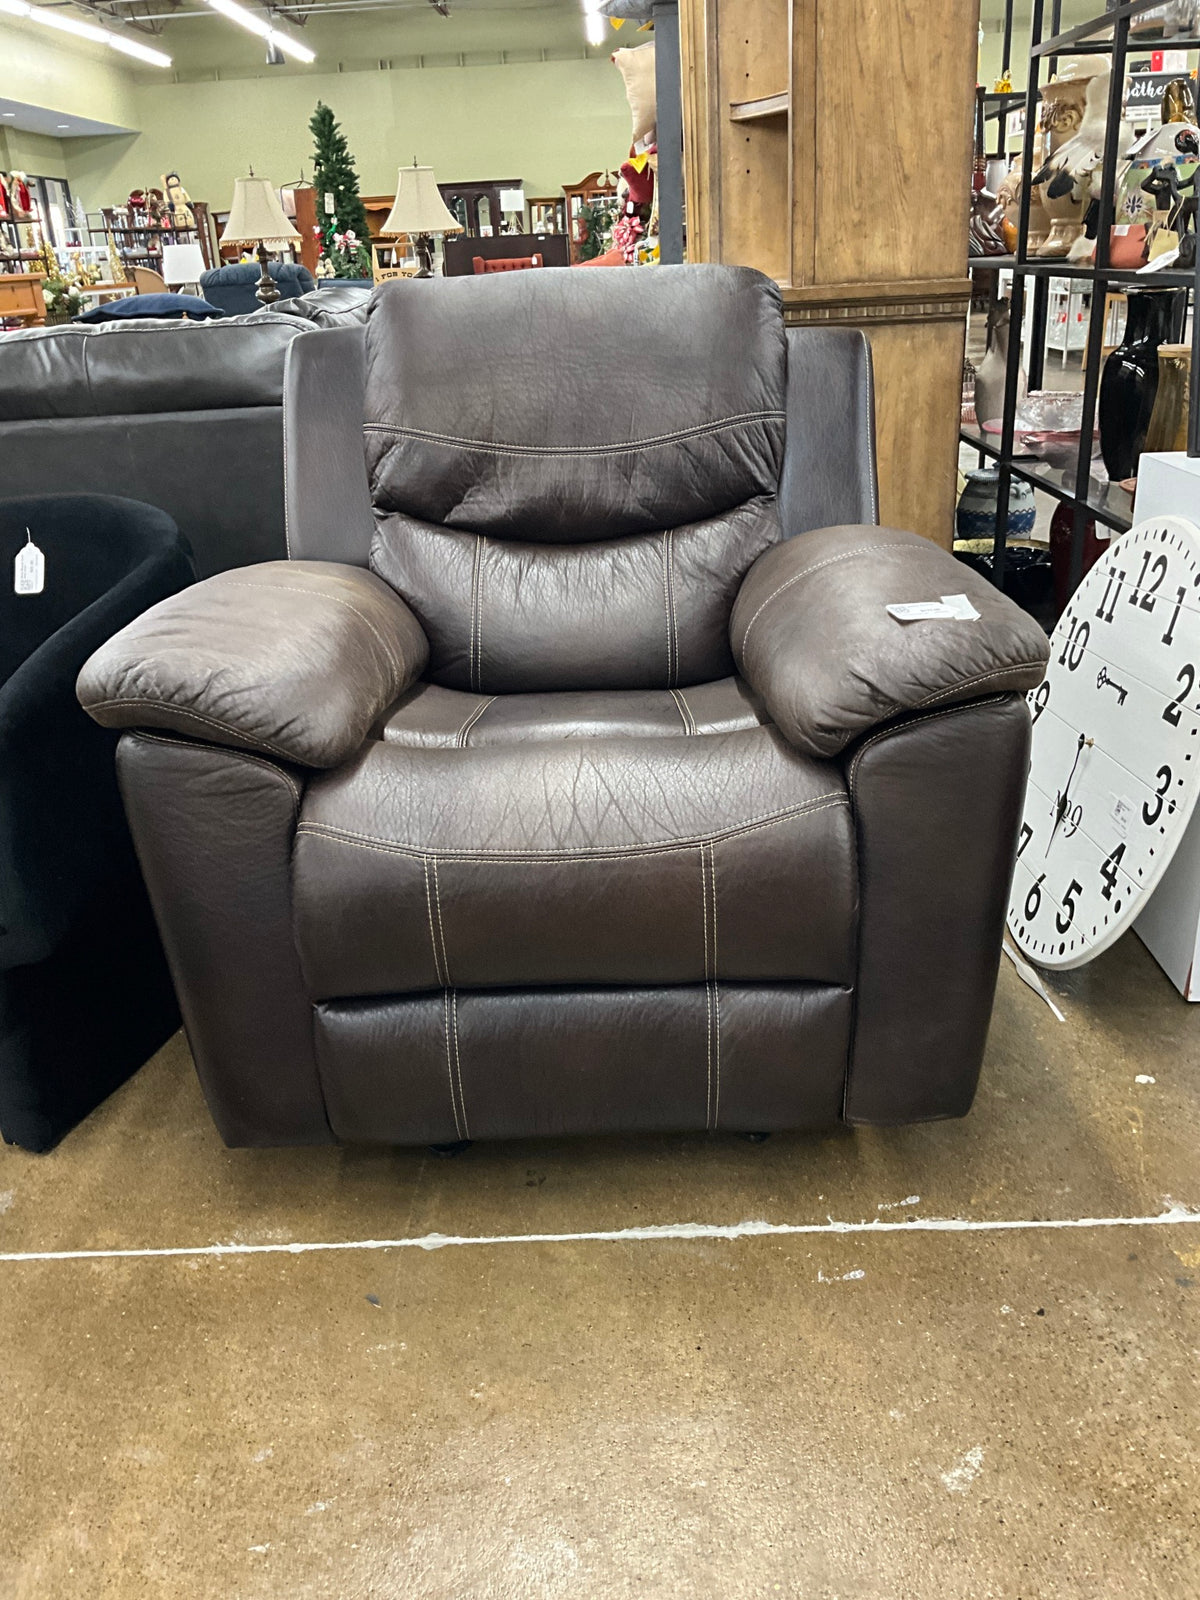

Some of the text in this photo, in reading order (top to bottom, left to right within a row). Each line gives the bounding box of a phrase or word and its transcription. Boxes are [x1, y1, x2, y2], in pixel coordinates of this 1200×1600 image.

[1095, 566, 1126, 624] 11
[1128, 550, 1168, 613] 12
[1058, 616, 1090, 672] 10
[1161, 586, 1187, 646] 1
[1032, 680, 1050, 726] 9
[1161, 663, 1195, 728] 2
[1142, 765, 1172, 825] 3
[1024, 873, 1047, 921] 6
[1100, 842, 1127, 901] 4
[1055, 878, 1083, 934] 5
